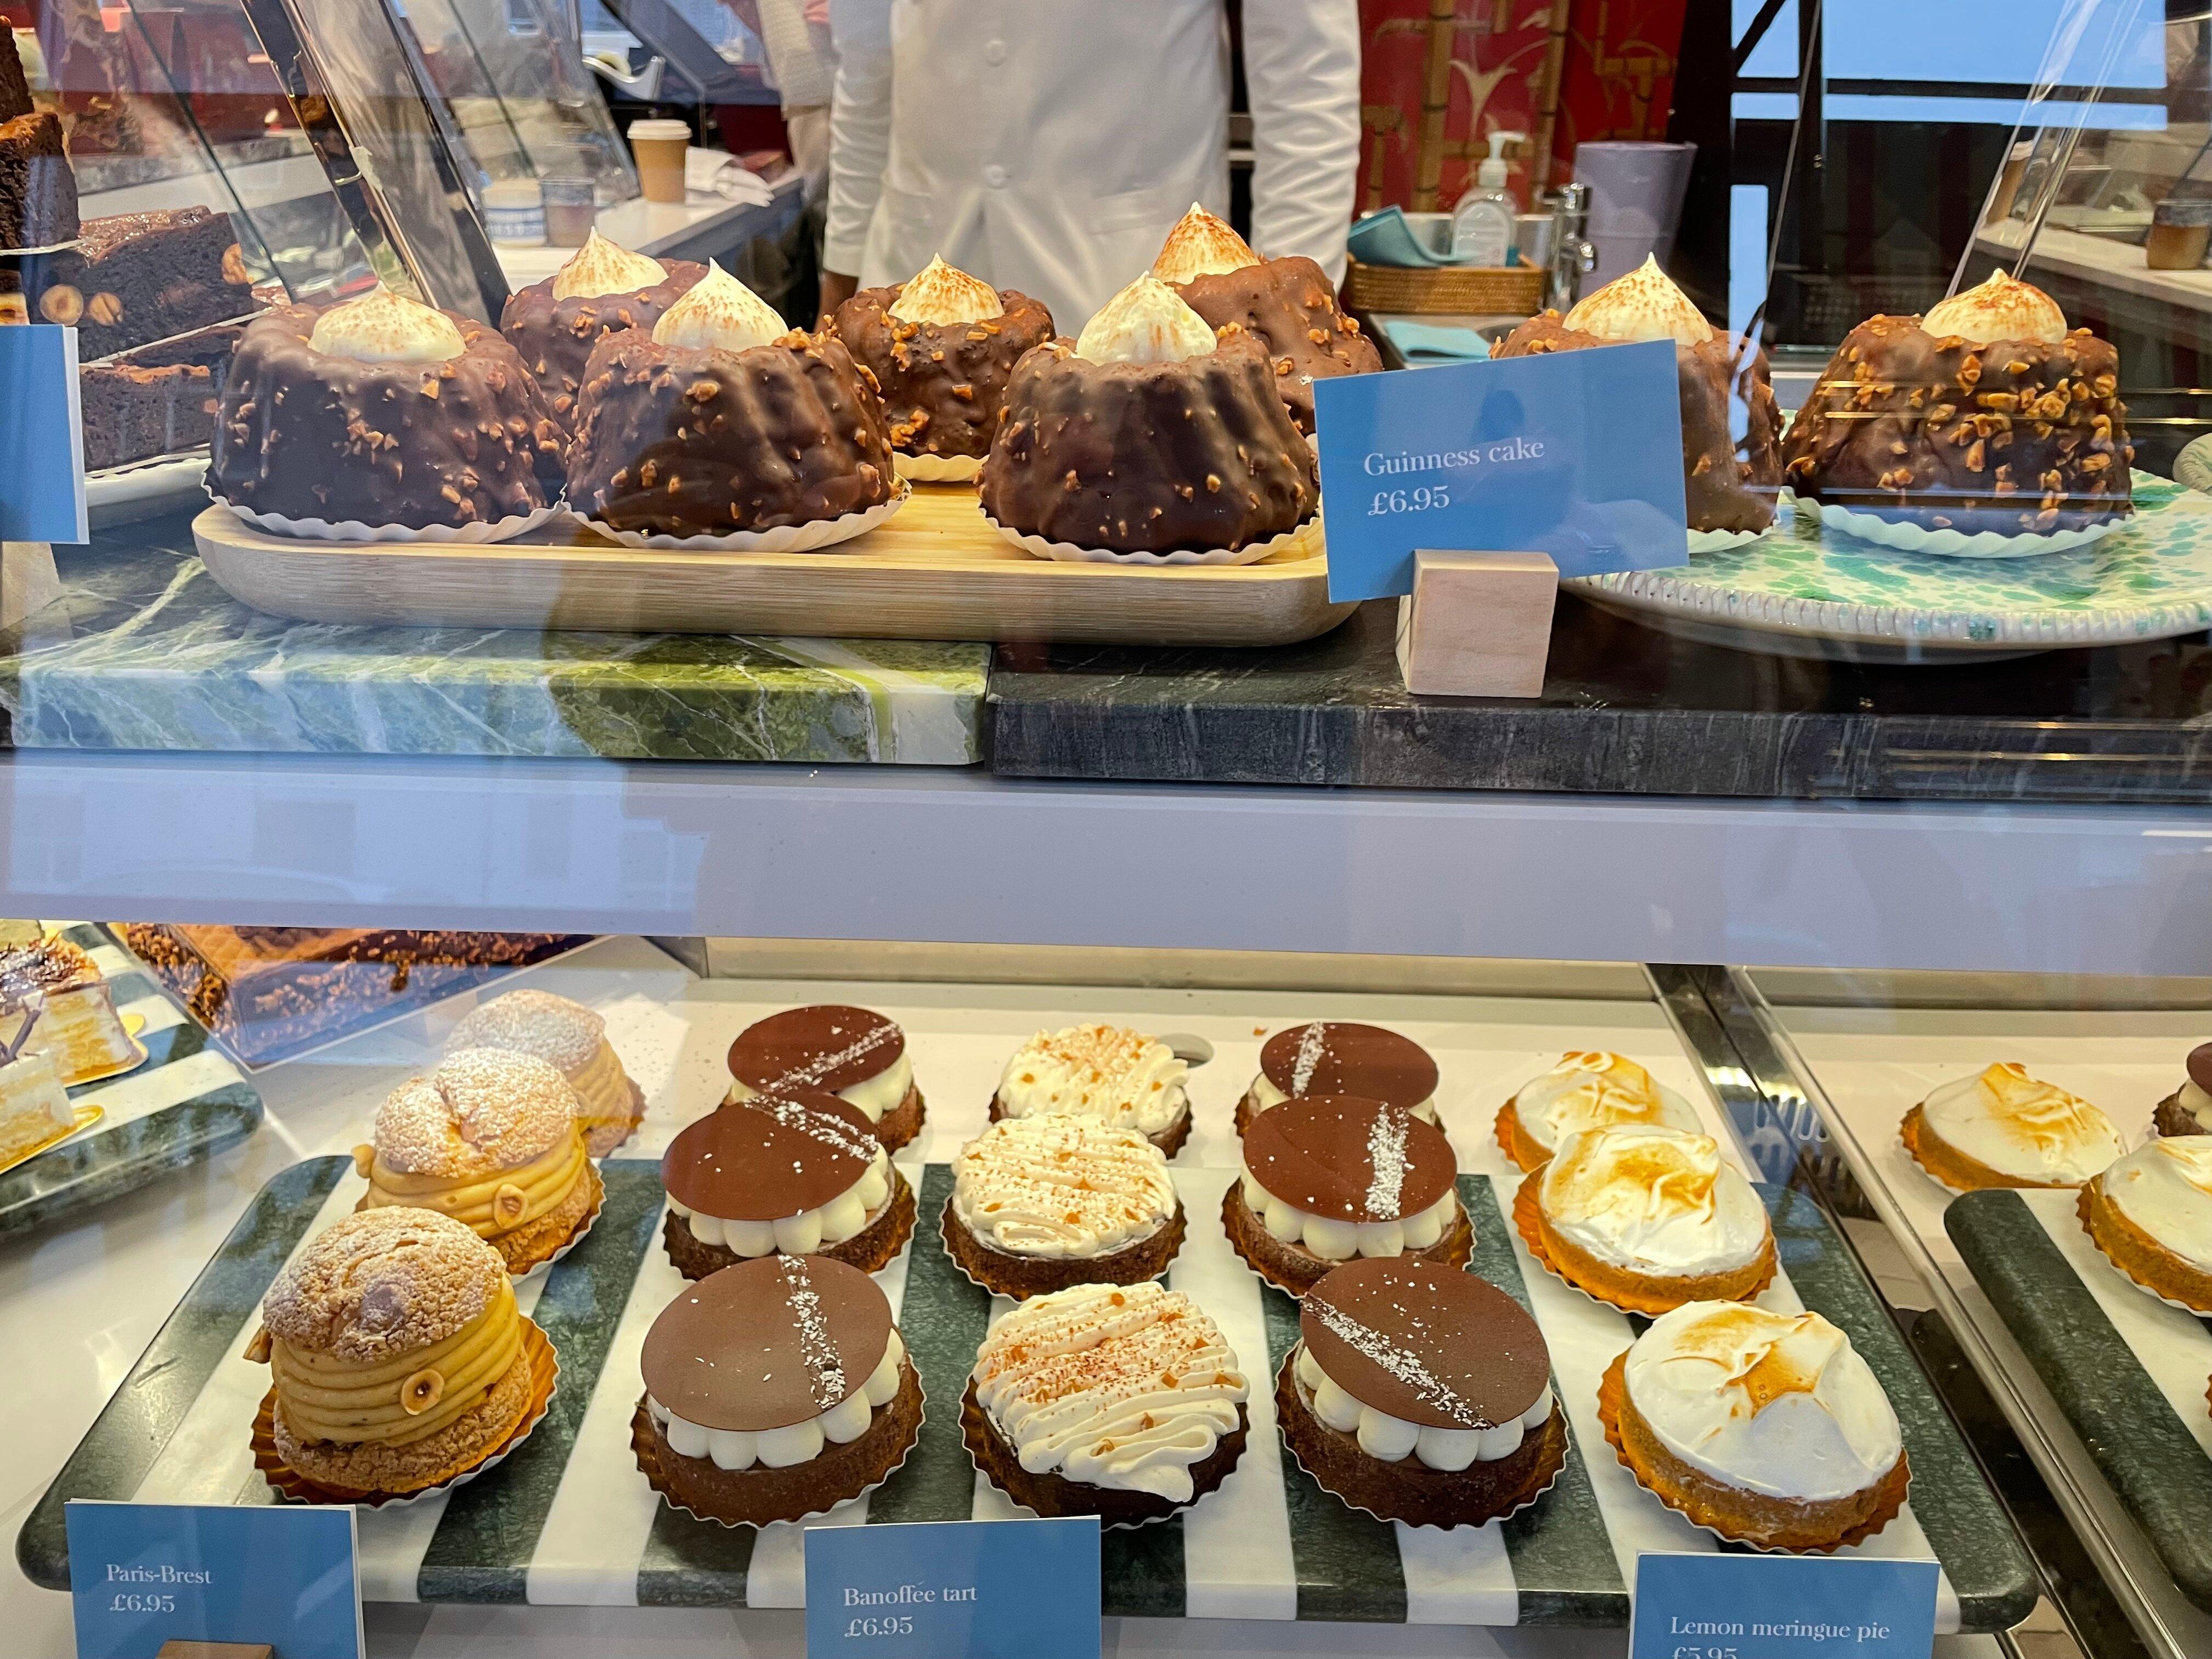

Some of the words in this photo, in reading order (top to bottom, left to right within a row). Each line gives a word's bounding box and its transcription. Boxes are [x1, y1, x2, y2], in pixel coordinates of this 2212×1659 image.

[1364, 449, 1481, 476] Guinness
[1488, 437, 1545, 462] cake
[1368, 486, 1450, 516] £6.95
[106, 1564, 212, 1584] Paris-Brest
[110, 1594, 175, 1612] £6.95
[943, 1586, 978, 1601] tart
[844, 1616, 913, 1637] £6.95
[1671, 1616, 1744, 1635] Lemon
[1752, 1620, 1851, 1641] meringue
[1857, 1622, 1890, 1643] pie
[1671, 1646, 1738, 1659] £595
